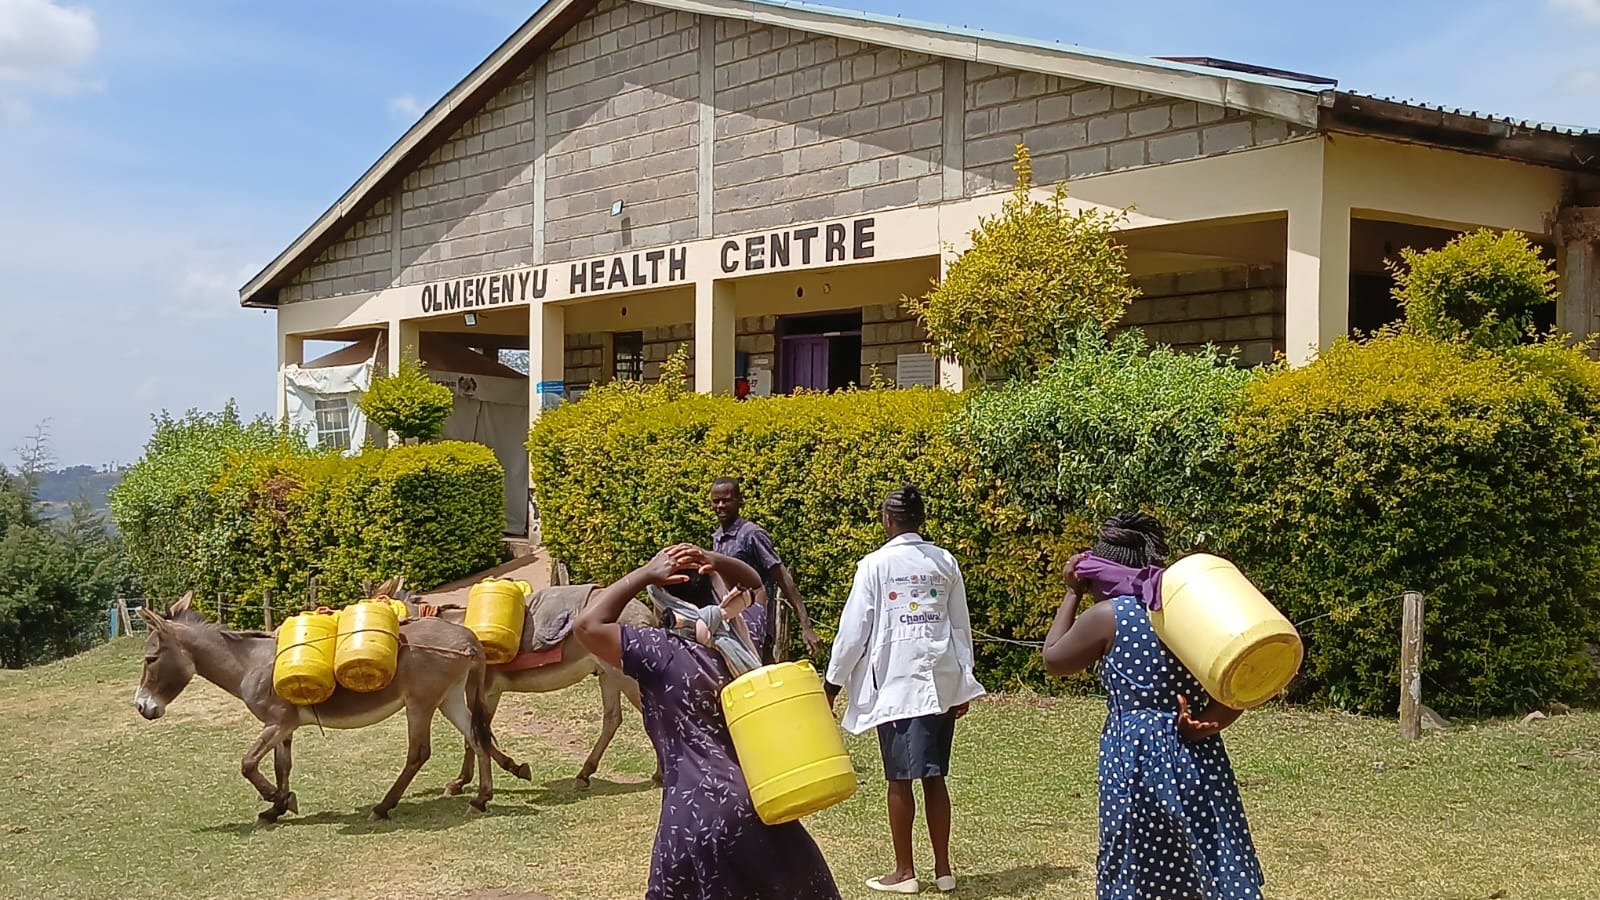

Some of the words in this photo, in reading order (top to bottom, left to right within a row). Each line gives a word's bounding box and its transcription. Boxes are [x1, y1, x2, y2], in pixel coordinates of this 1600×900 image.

[421, 268, 548, 313] OLMEKENYU
[569, 246, 687, 295] HEALTH
[720, 217, 875, 274] CENTRE
